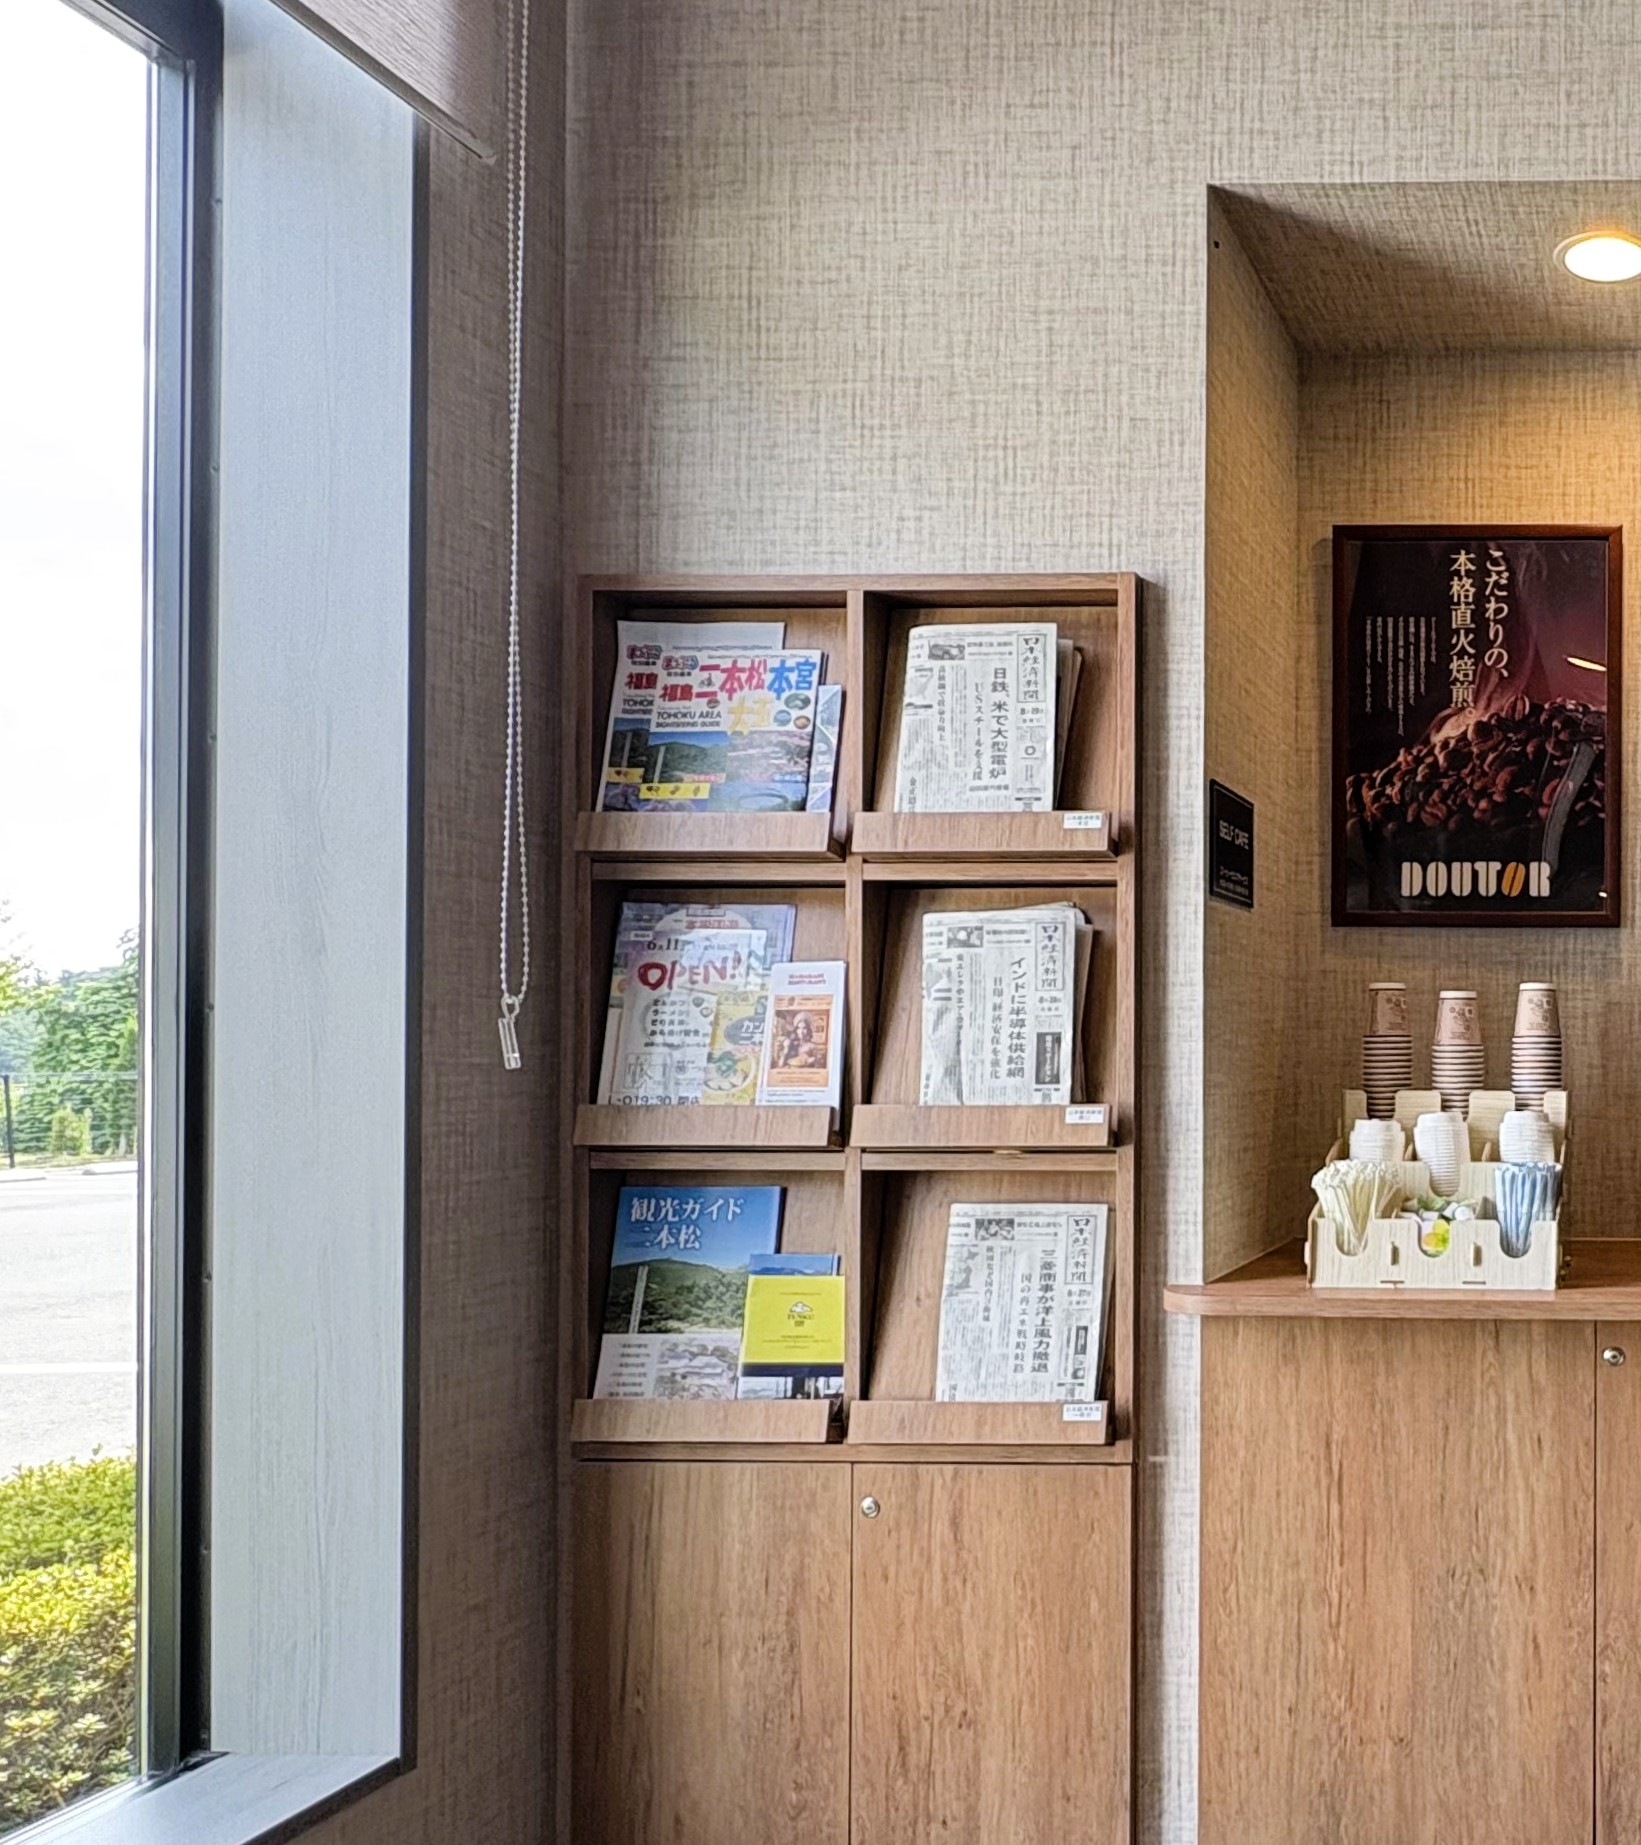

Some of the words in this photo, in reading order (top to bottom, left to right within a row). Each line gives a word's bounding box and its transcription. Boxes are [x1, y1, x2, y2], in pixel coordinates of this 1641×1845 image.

[1449, 549, 1477, 718] 本格直火焙煎。
[1484, 549, 1509, 678] こだわりの、
[656, 710, 696, 720] TOHOKU
[698, 709, 722, 719] AREA
[989, 667, 1010, 780] 日鉄、米で大型電炉
[1401, 861, 1551, 897] DOUTOR
[1006, 957, 1028, 1079] インドに半導体供給網
[631, 1197, 744, 1222] 観光ガイド
